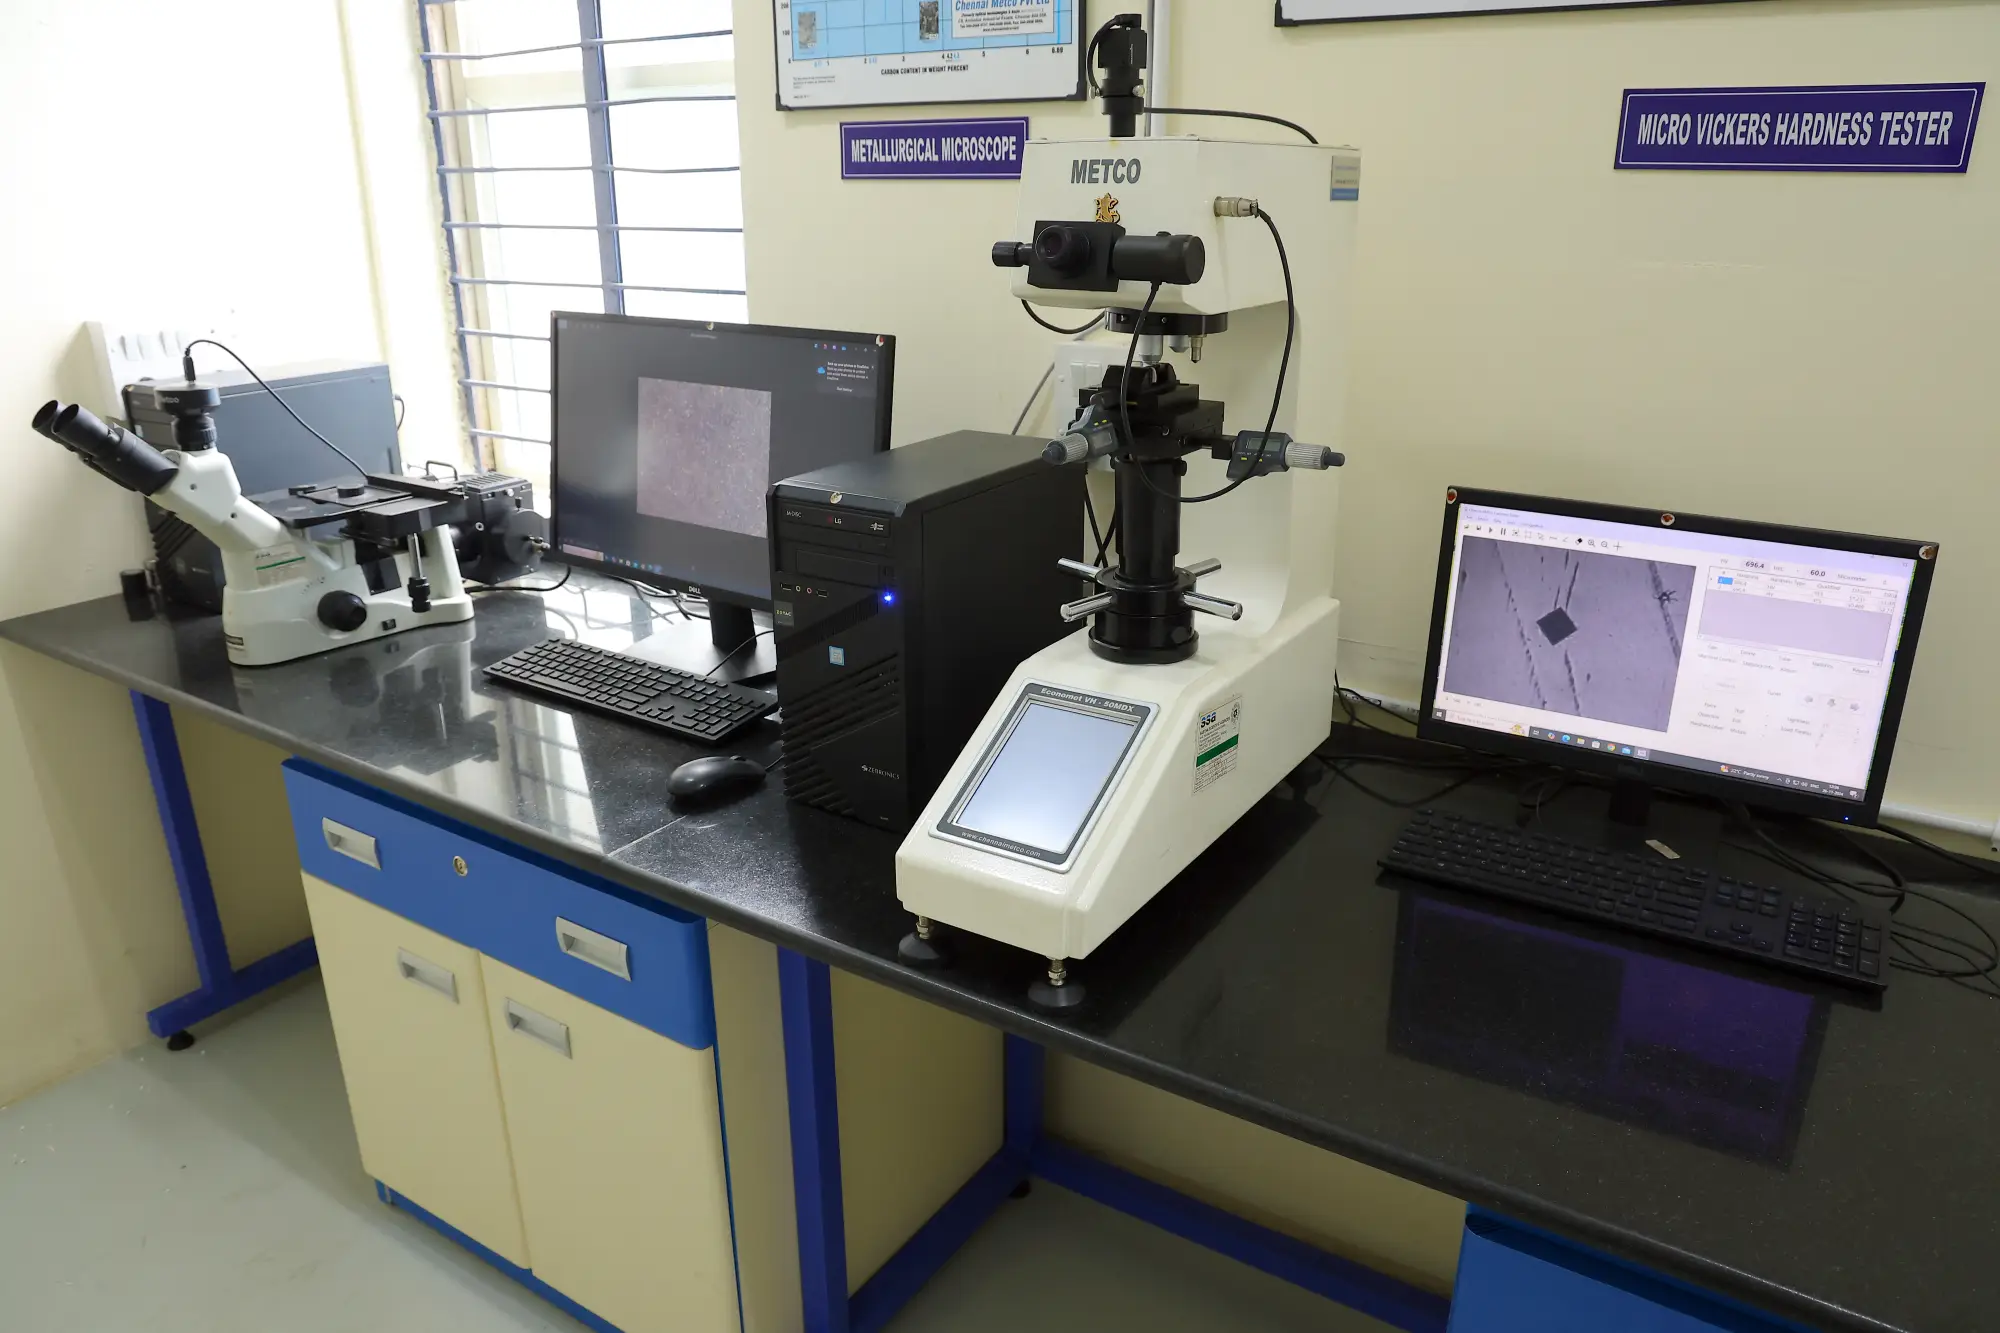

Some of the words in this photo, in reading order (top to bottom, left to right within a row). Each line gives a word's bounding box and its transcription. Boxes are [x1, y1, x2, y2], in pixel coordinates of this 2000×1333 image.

[900, 66, 921, 75] CONTENT
[928, 65, 946, 73] WEIGHT
[947, 64, 969, 72] PERCENT
[1637, 113, 1692, 145] MICRO
[1696, 112, 1770, 145] VICKERS
[1773, 112, 1873, 146] HARDNESS
[1879, 111, 1953, 146] TESTER
[851, 137, 939, 163] METALLURGICAL
[941, 136, 1017, 162] MICROSCOPE
[1070, 158, 1142, 185] METCO
[834, 517, 842, 525] LG
[1745, 561, 1765, 569] 696.4
[1810, 569, 1826, 577] 60.0
[689, 585, 701, 595] DELL
[1040, 687, 1083, 702] Economet
[1084, 696, 1098, 705] VH
[1103, 700, 1135, 713] 50MDX
[961, 832, 1041, 858] www.chennaimetco.com
